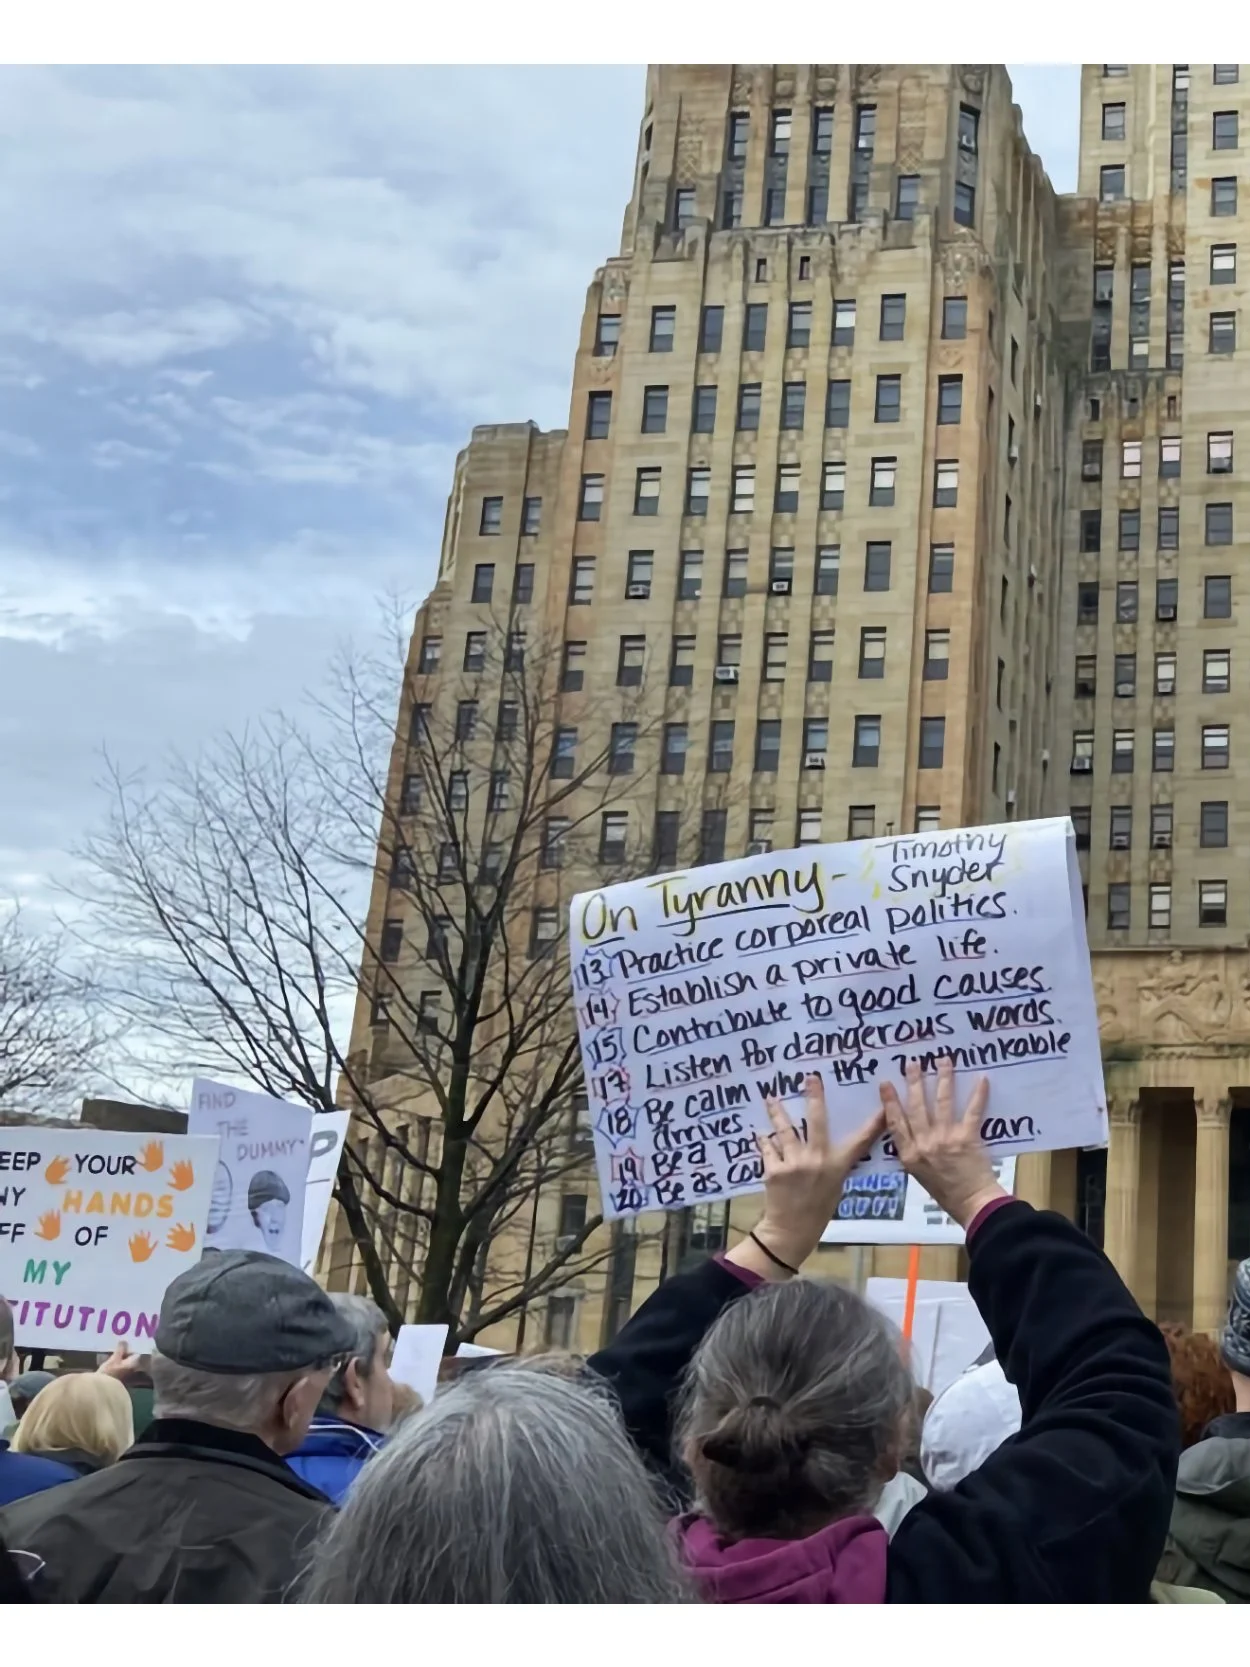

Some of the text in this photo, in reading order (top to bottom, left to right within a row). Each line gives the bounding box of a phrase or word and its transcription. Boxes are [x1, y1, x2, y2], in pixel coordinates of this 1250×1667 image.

[875, 833, 1008, 863] Timothy
[888, 858, 1005, 897] Snyder
[582, 892, 638, 940] On
[614, 937, 723, 978] Practice
[735, 905, 870, 951] corporeal
[885, 891, 1018, 934] politics.
[628, 971, 758, 1017] Establish
[765, 963, 786, 986] a
[791, 941, 917, 985] private
[937, 928, 999, 958] life.
[633, 1000, 792, 1055] Contribute
[802, 991, 833, 1019] to
[837, 974, 921, 1028] good
[646, 1052, 733, 1089] Listen
[740, 1038, 778, 1068] for
[783, 1011, 955, 1060] dangerous
[966, 998, 1063, 1031] words.
[199, 1092, 237, 1110] AND
[607, 1106, 632, 1137] 18
[645, 1097, 676, 1125] Be
[684, 1082, 752, 1119] calm
[832, 1057, 879, 1083] the
[216, 1118, 250, 1139] THE
[652, 1112, 755, 1152] arrives.
[980, 1115, 1042, 1141] can.
[0, 1151, 137, 1176] EEP YOUR
[651, 1150, 683, 1176] Be
[688, 1141, 707, 1165] a
[62, 1189, 174, 1219] HANDS
[653, 1183, 685, 1205] Be
[693, 1170, 723, 1194] as
[75, 1225, 109, 1247] OF
[23, 1258, 72, 1286] MY
